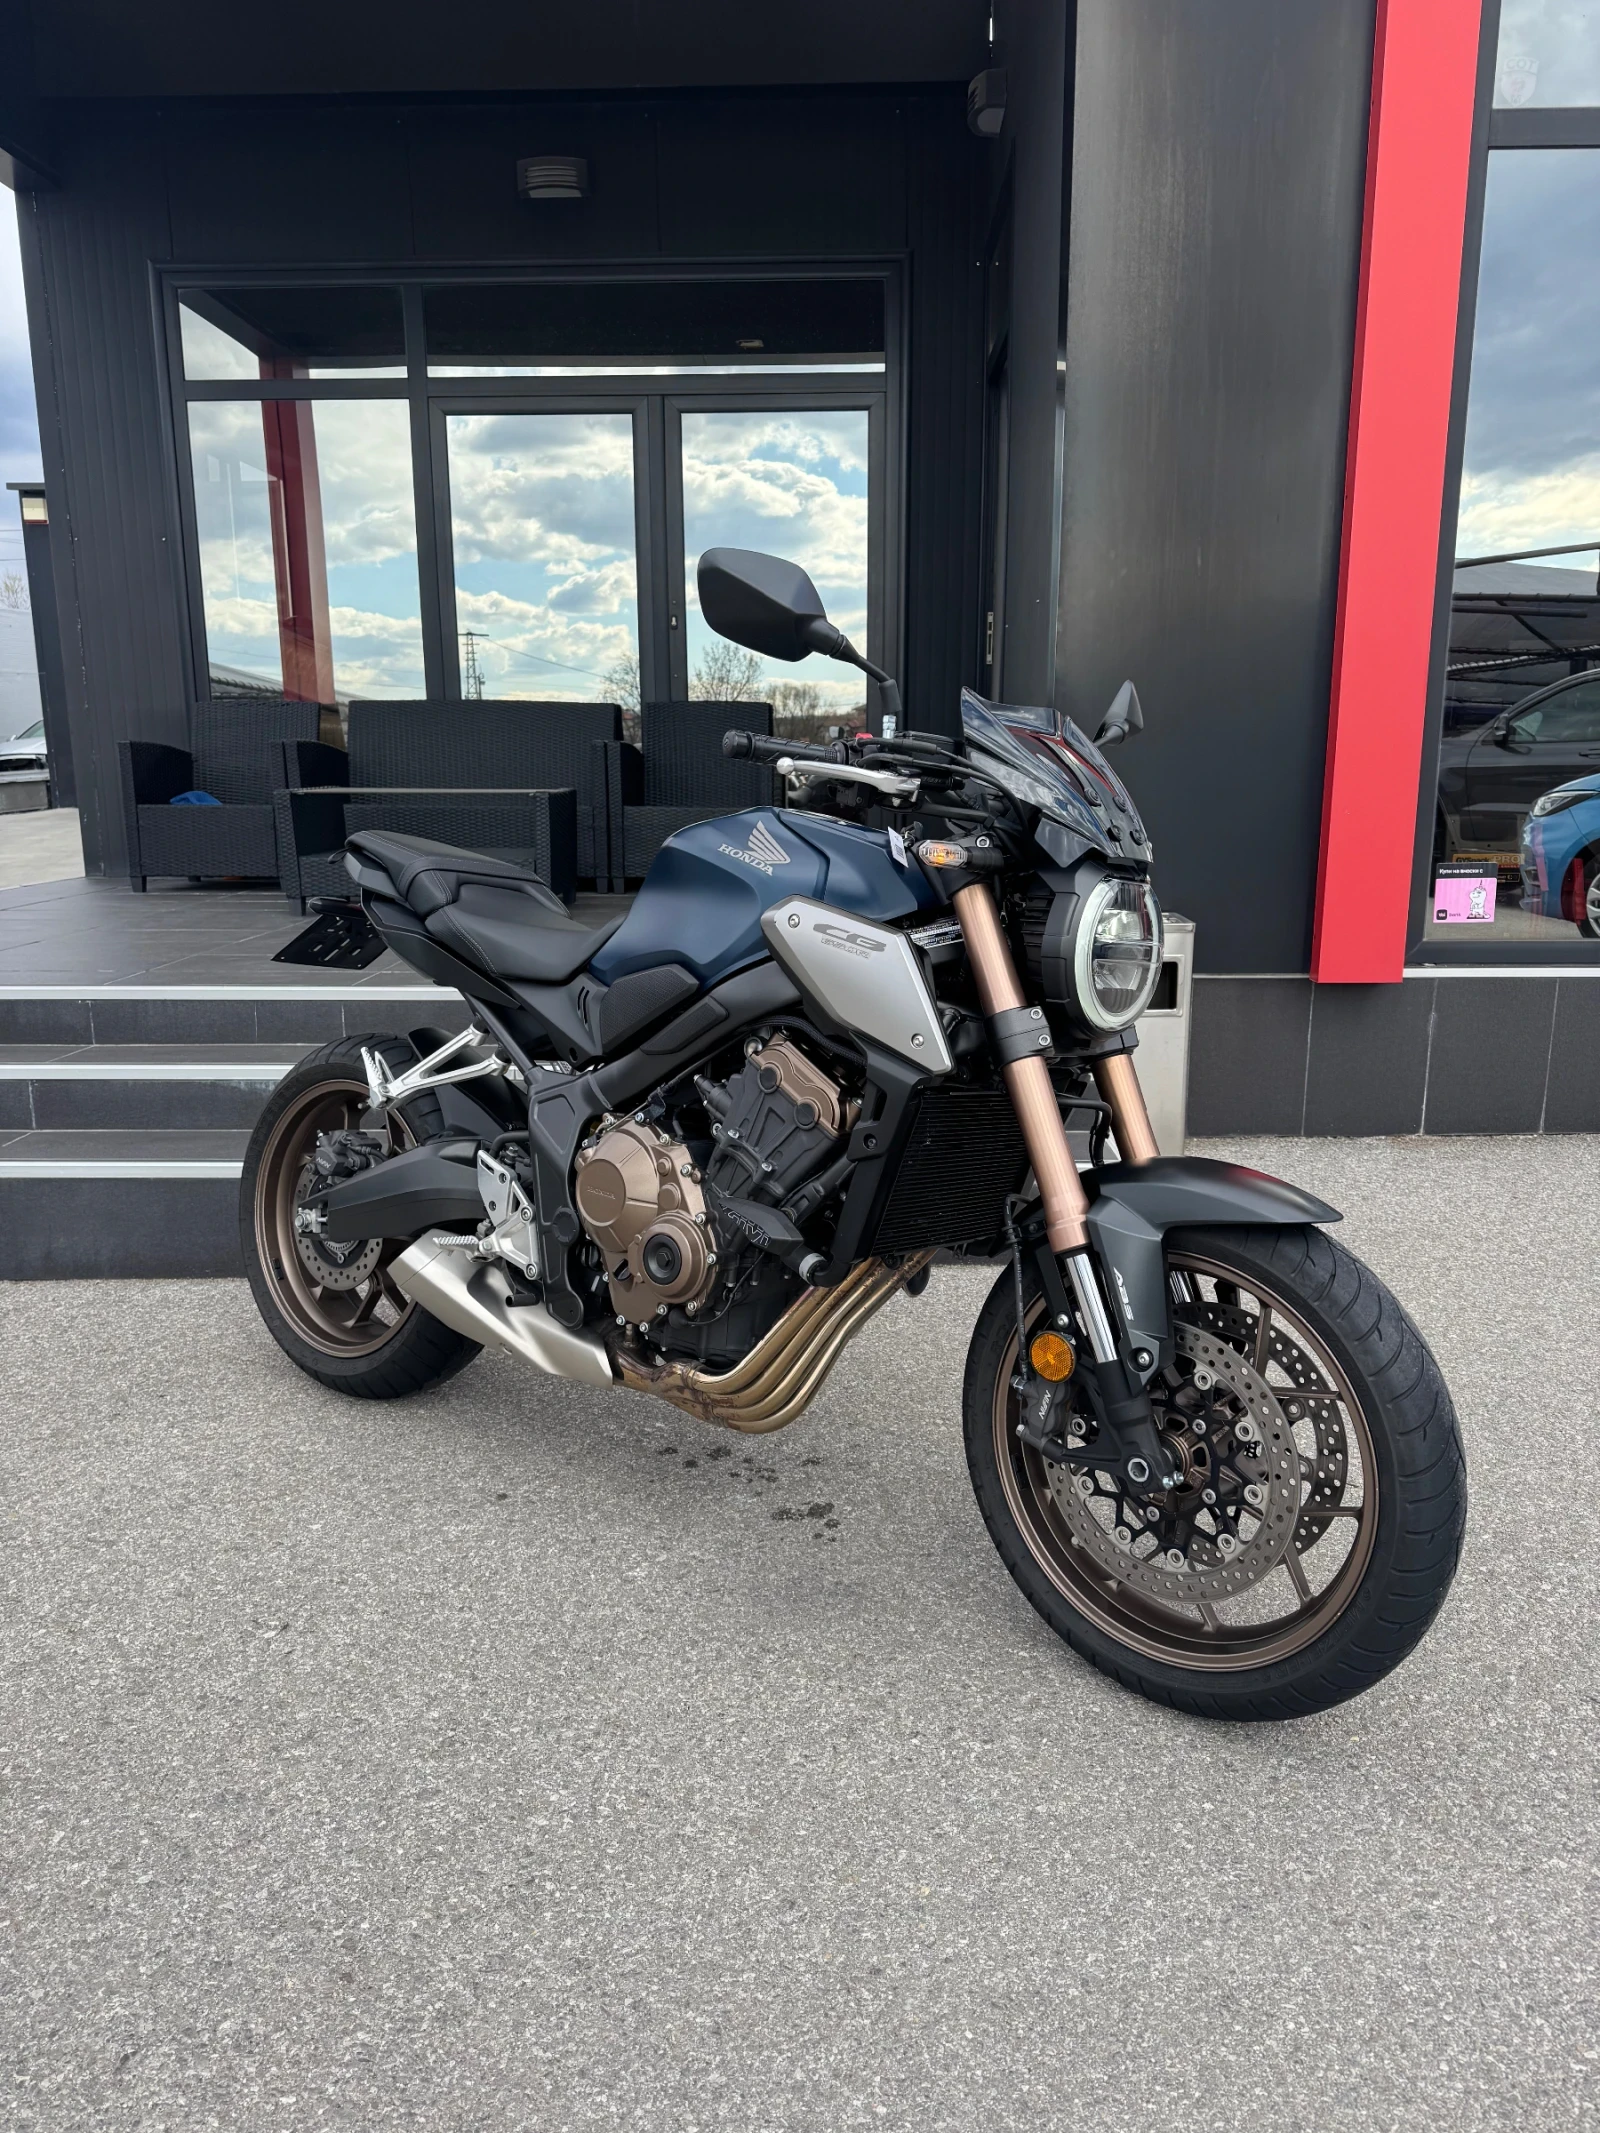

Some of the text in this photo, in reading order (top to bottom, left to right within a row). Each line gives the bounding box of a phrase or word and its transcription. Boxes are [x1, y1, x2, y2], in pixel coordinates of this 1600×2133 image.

[717, 843, 774, 876] HONDA
[1493, 855, 1520, 864] PRO
[813, 923, 887, 952] CB
[1113, 1266, 1135, 1321] ABS
